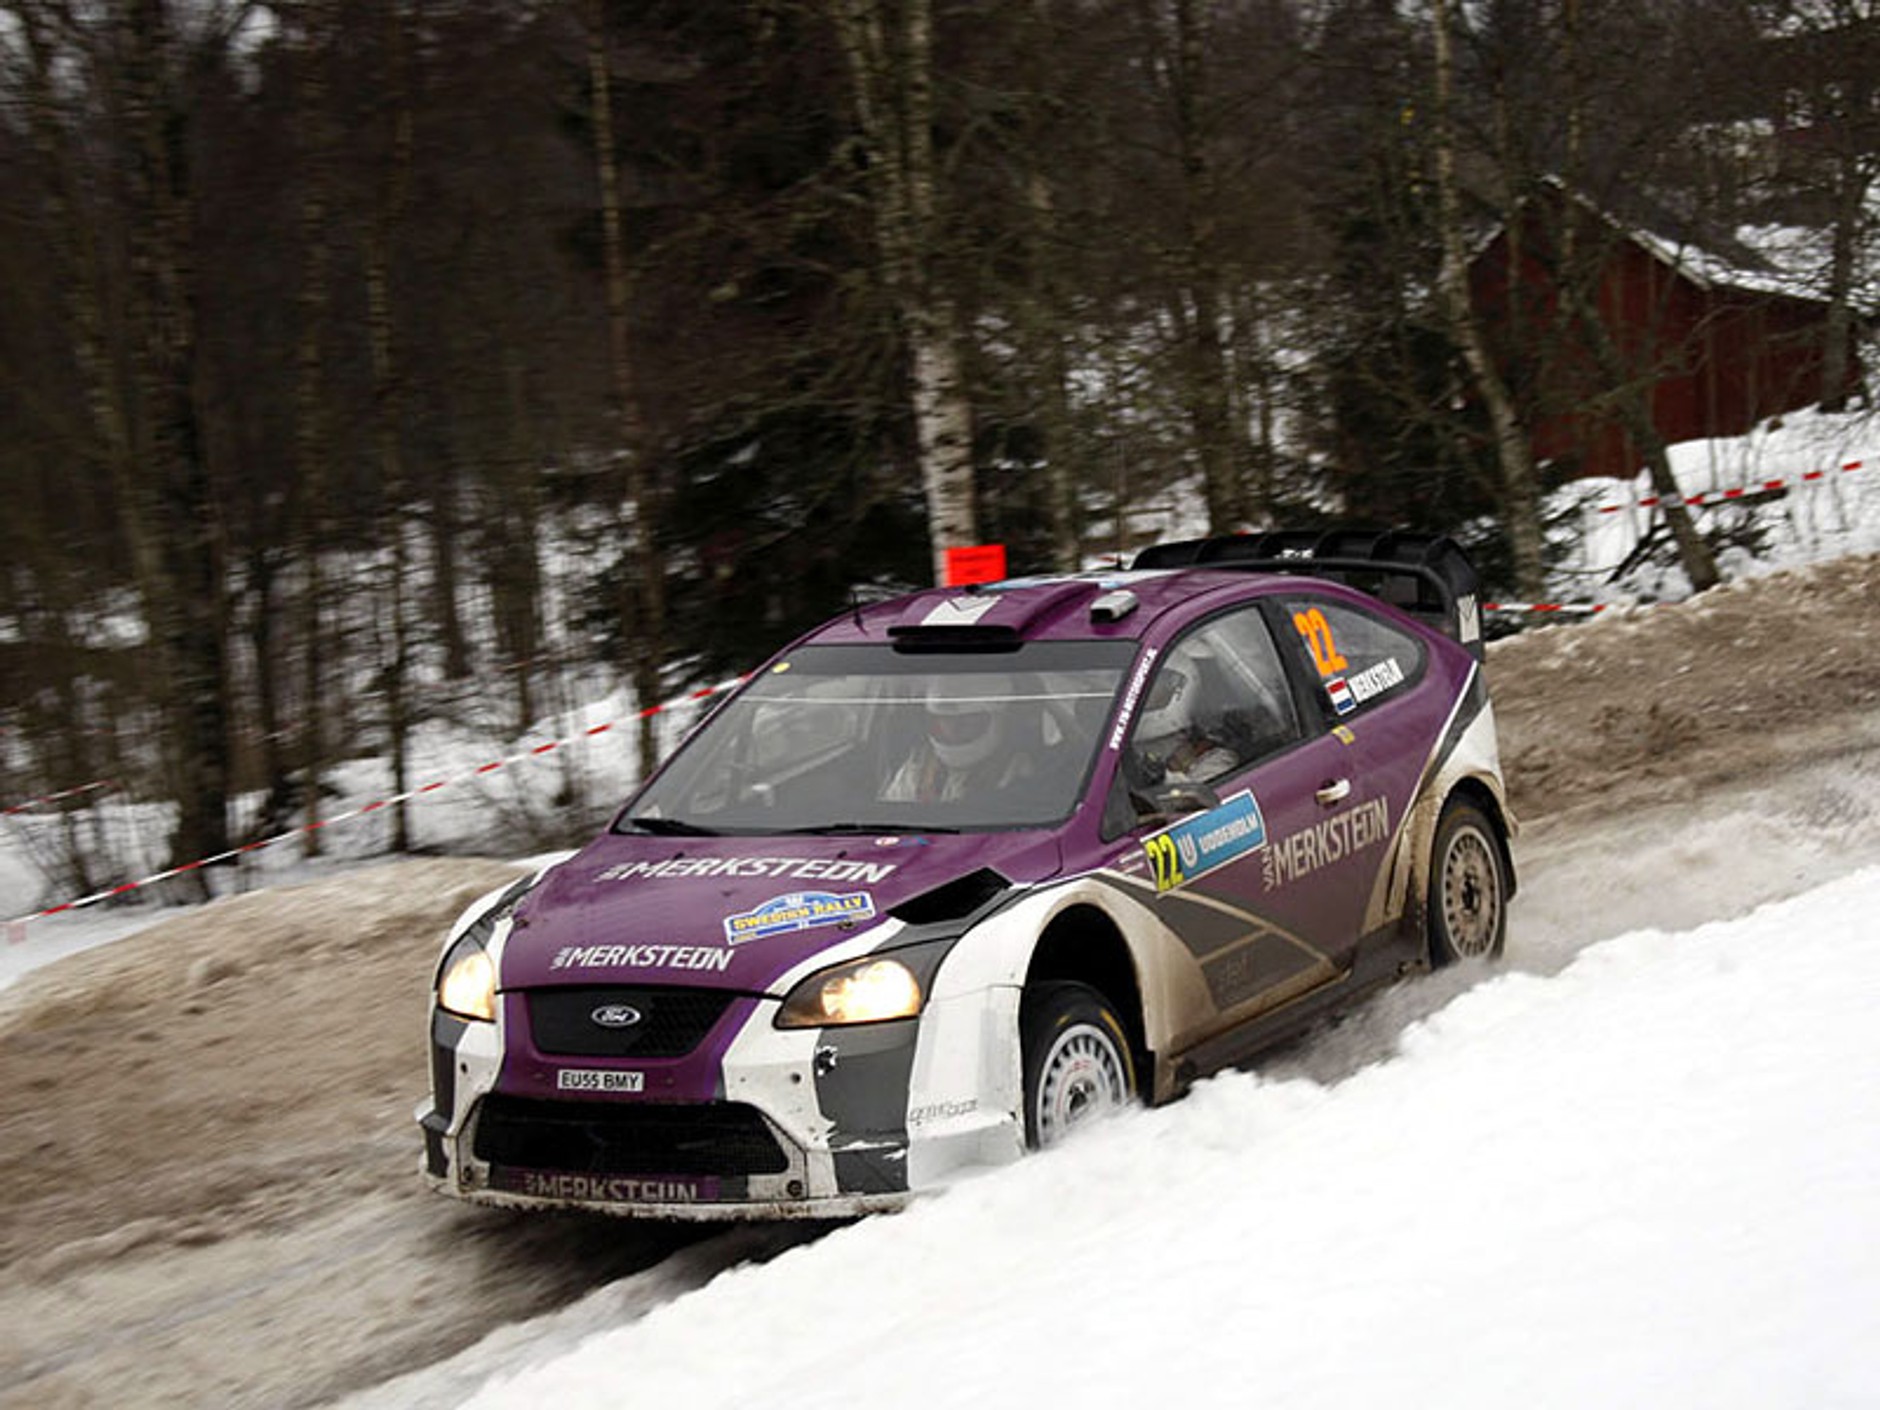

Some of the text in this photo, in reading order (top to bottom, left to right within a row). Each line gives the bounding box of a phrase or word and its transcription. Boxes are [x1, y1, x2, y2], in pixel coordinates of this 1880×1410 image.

[1292, 607, 1348, 678] 22
[1145, 834, 1184, 892] 22
[812, 896, 863, 914] RALLY
[561, 1072, 639, 1089] EU55 BMY
